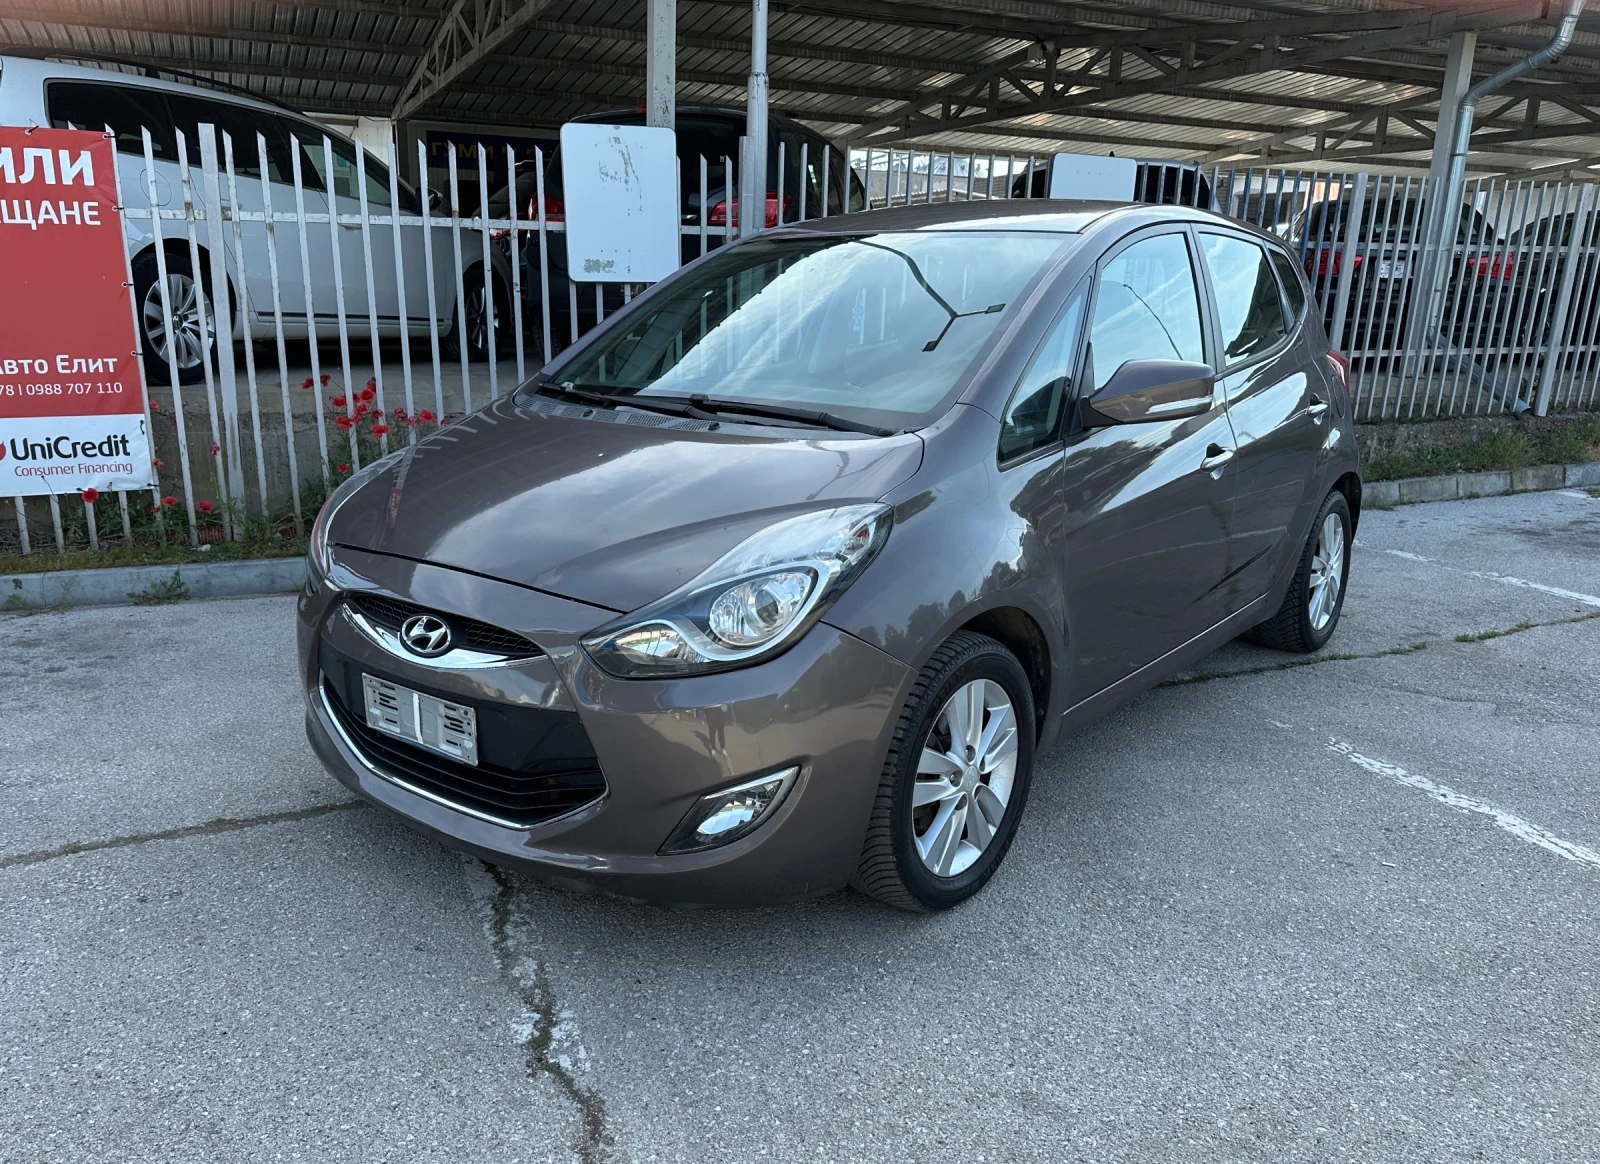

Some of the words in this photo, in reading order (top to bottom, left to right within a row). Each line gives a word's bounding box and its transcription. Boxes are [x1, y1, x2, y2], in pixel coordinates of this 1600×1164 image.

[0, 200, 101, 230] ЩАНЕ
[0, 359, 49, 375] вто
[56, 354, 118, 374] Елит
[26, 383, 63, 396] 0988
[66, 383, 92, 395] 707
[97, 382, 123, 394] 110
[10, 434, 131, 460] UniCredit
[15, 465, 75, 477] Consumer
[78, 461, 133, 475] Financing
